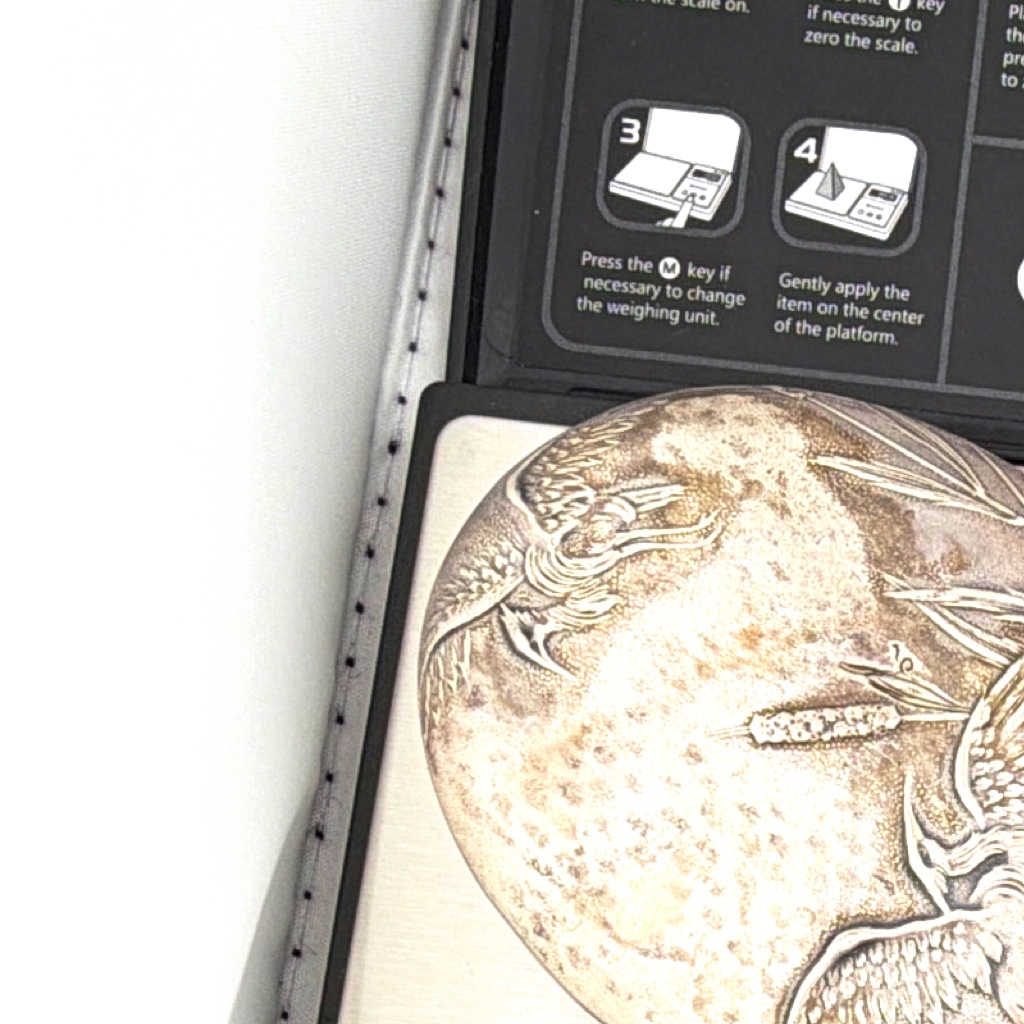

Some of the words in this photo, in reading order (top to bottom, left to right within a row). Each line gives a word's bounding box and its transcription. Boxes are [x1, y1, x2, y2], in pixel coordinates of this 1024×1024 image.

[725, 3, 750, 13] on.
[807, 4, 819, 19] if
[822, 9, 901, 33] necessary
[905, 17, 922, 32] to
[803, 30, 840, 45] zero
[844, 32, 871, 48] the
[875, 37, 919, 55] scale.
[1001, 74, 1018, 88] to
[619, 117, 641, 144] 3
[793, 138, 818, 163] 4
[581, 251, 623, 270] Press
[627, 256, 653, 273] the
[687, 262, 716, 283] key
[719, 265, 732, 281] if
[583, 277, 661, 300] necessary
[666, 284, 683, 299] to
[687, 286, 746, 309] change
[779, 272, 831, 295] Gently
[835, 279, 881, 301] apply
[884, 286, 911, 301] the
[577, 296, 603, 313] the
[606, 301, 680, 325] weighing
[685, 309, 720, 326] unit.
[776, 295, 812, 312] item
[817, 303, 839, 317] on
[842, 302, 869, 320] the
[873, 309, 925, 325] center
[774, 318, 793, 334] of
[795, 320, 822, 337] the
[825, 322, 898, 345] platform.
